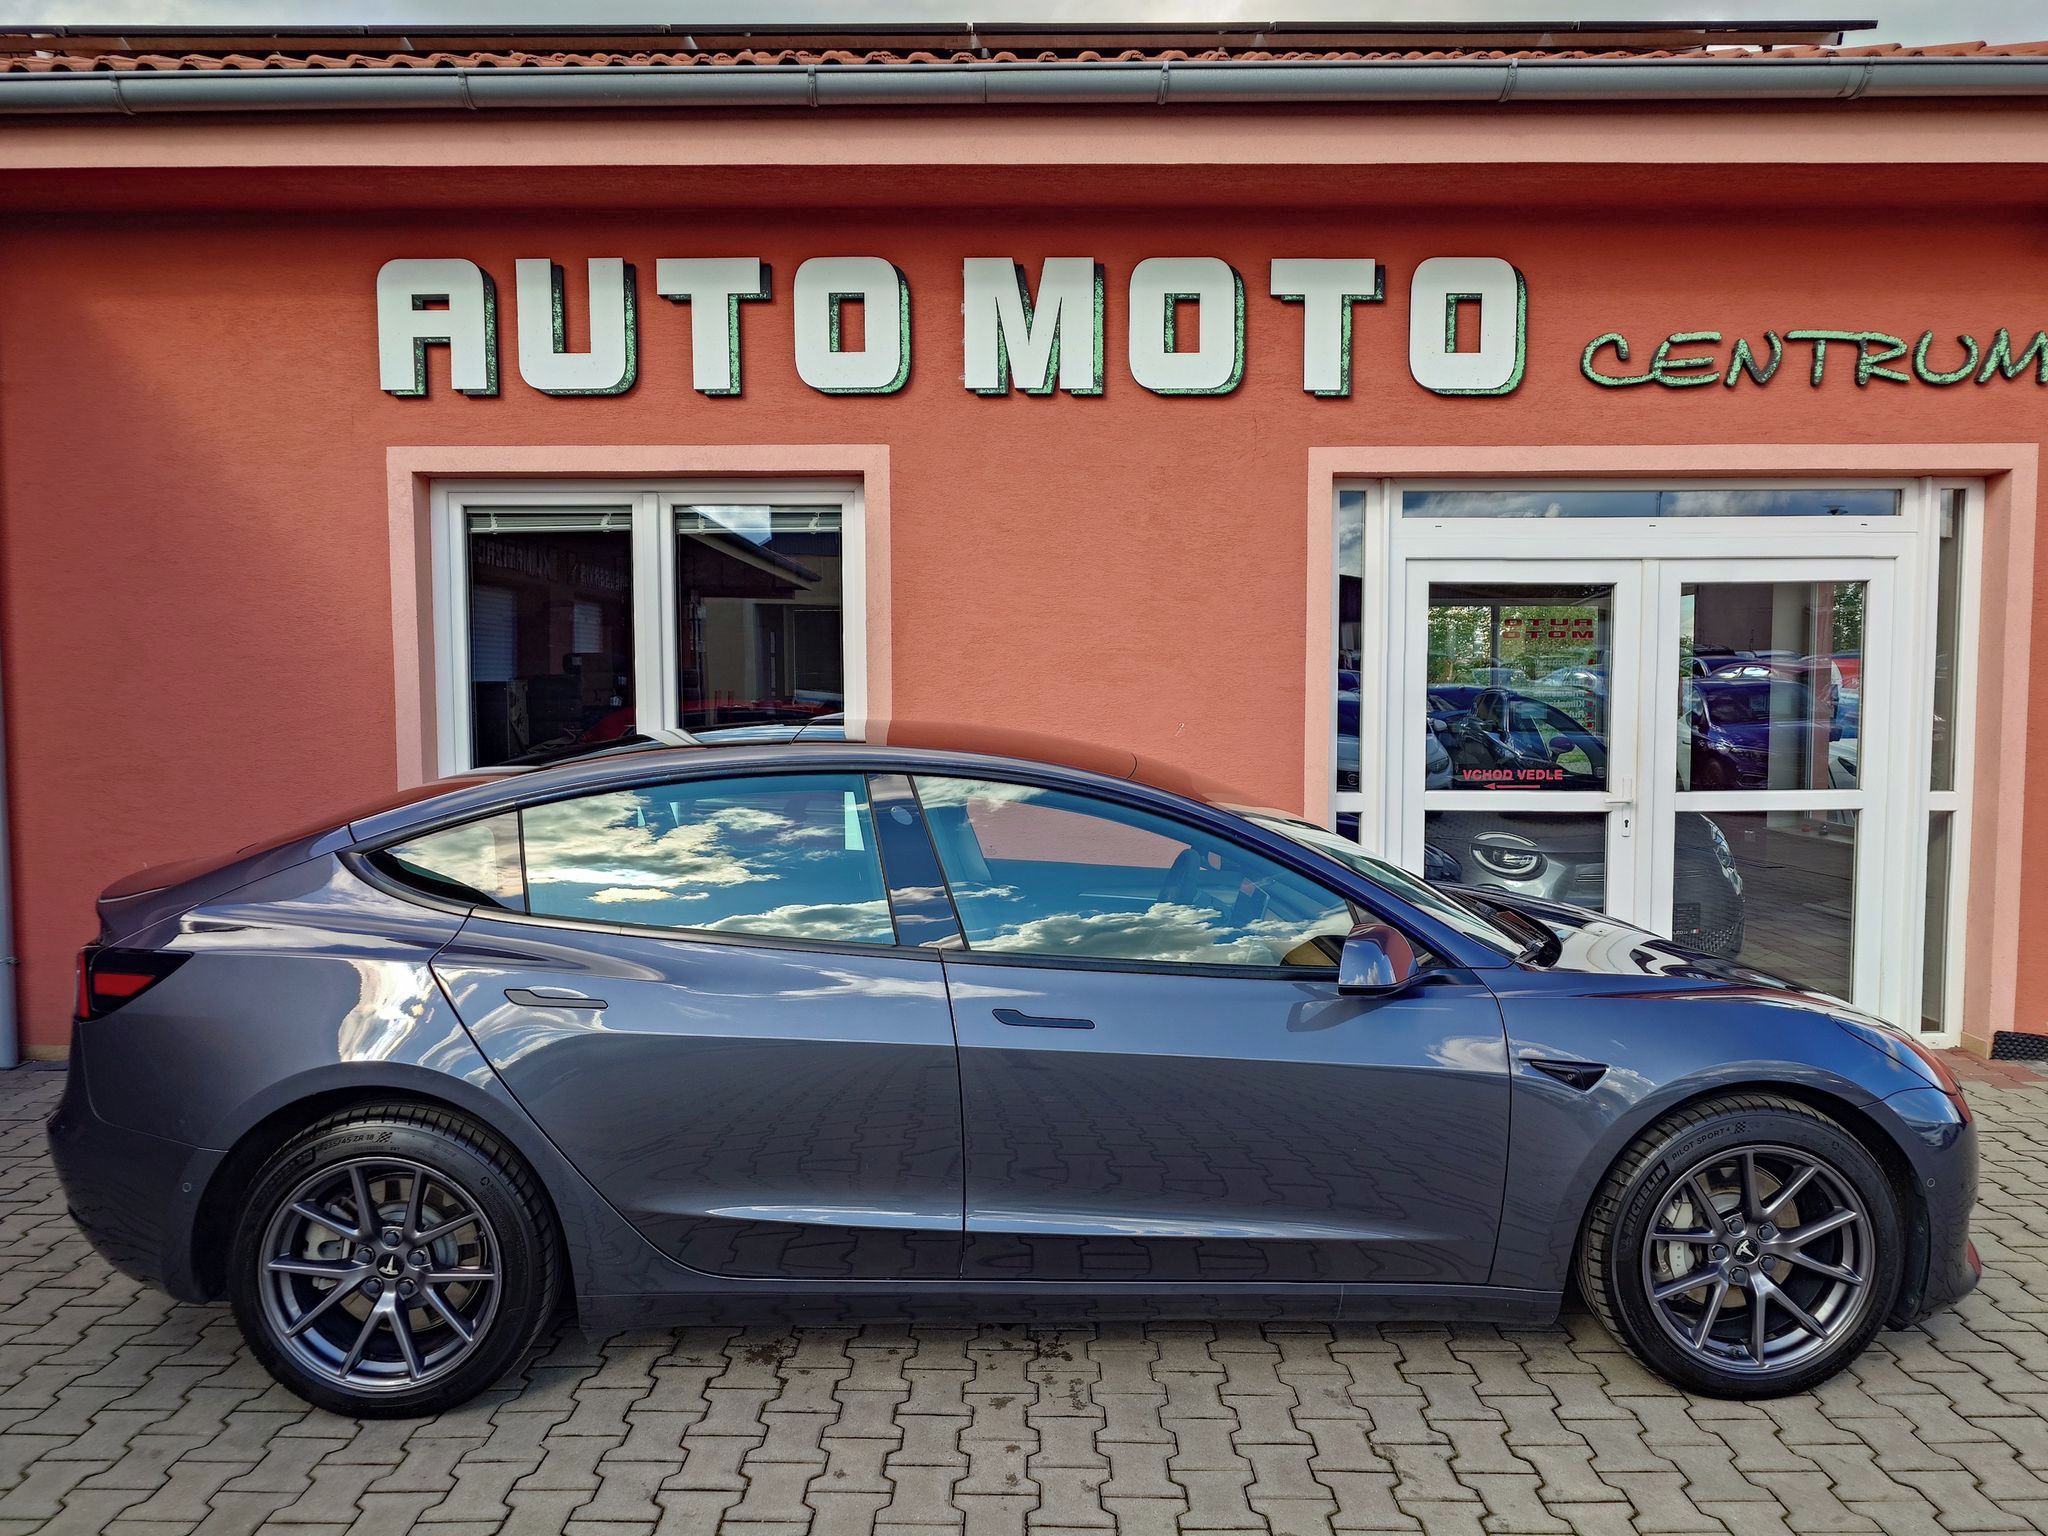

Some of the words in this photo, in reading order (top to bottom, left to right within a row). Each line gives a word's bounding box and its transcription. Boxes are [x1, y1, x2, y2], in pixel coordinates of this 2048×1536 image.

[376, 256, 911, 396] AUTO
[962, 256, 1528, 396] MOTO
[1579, 327, 2048, 387] CENTRUM
[1462, 769, 1513, 781] VCHOD
[1516, 769, 1563, 781] VEDLE
[1671, 1142, 1694, 1160] PILOT
[1697, 1128, 1725, 1144] SPORT
[1623, 1163, 1669, 1236] MICHELIN
